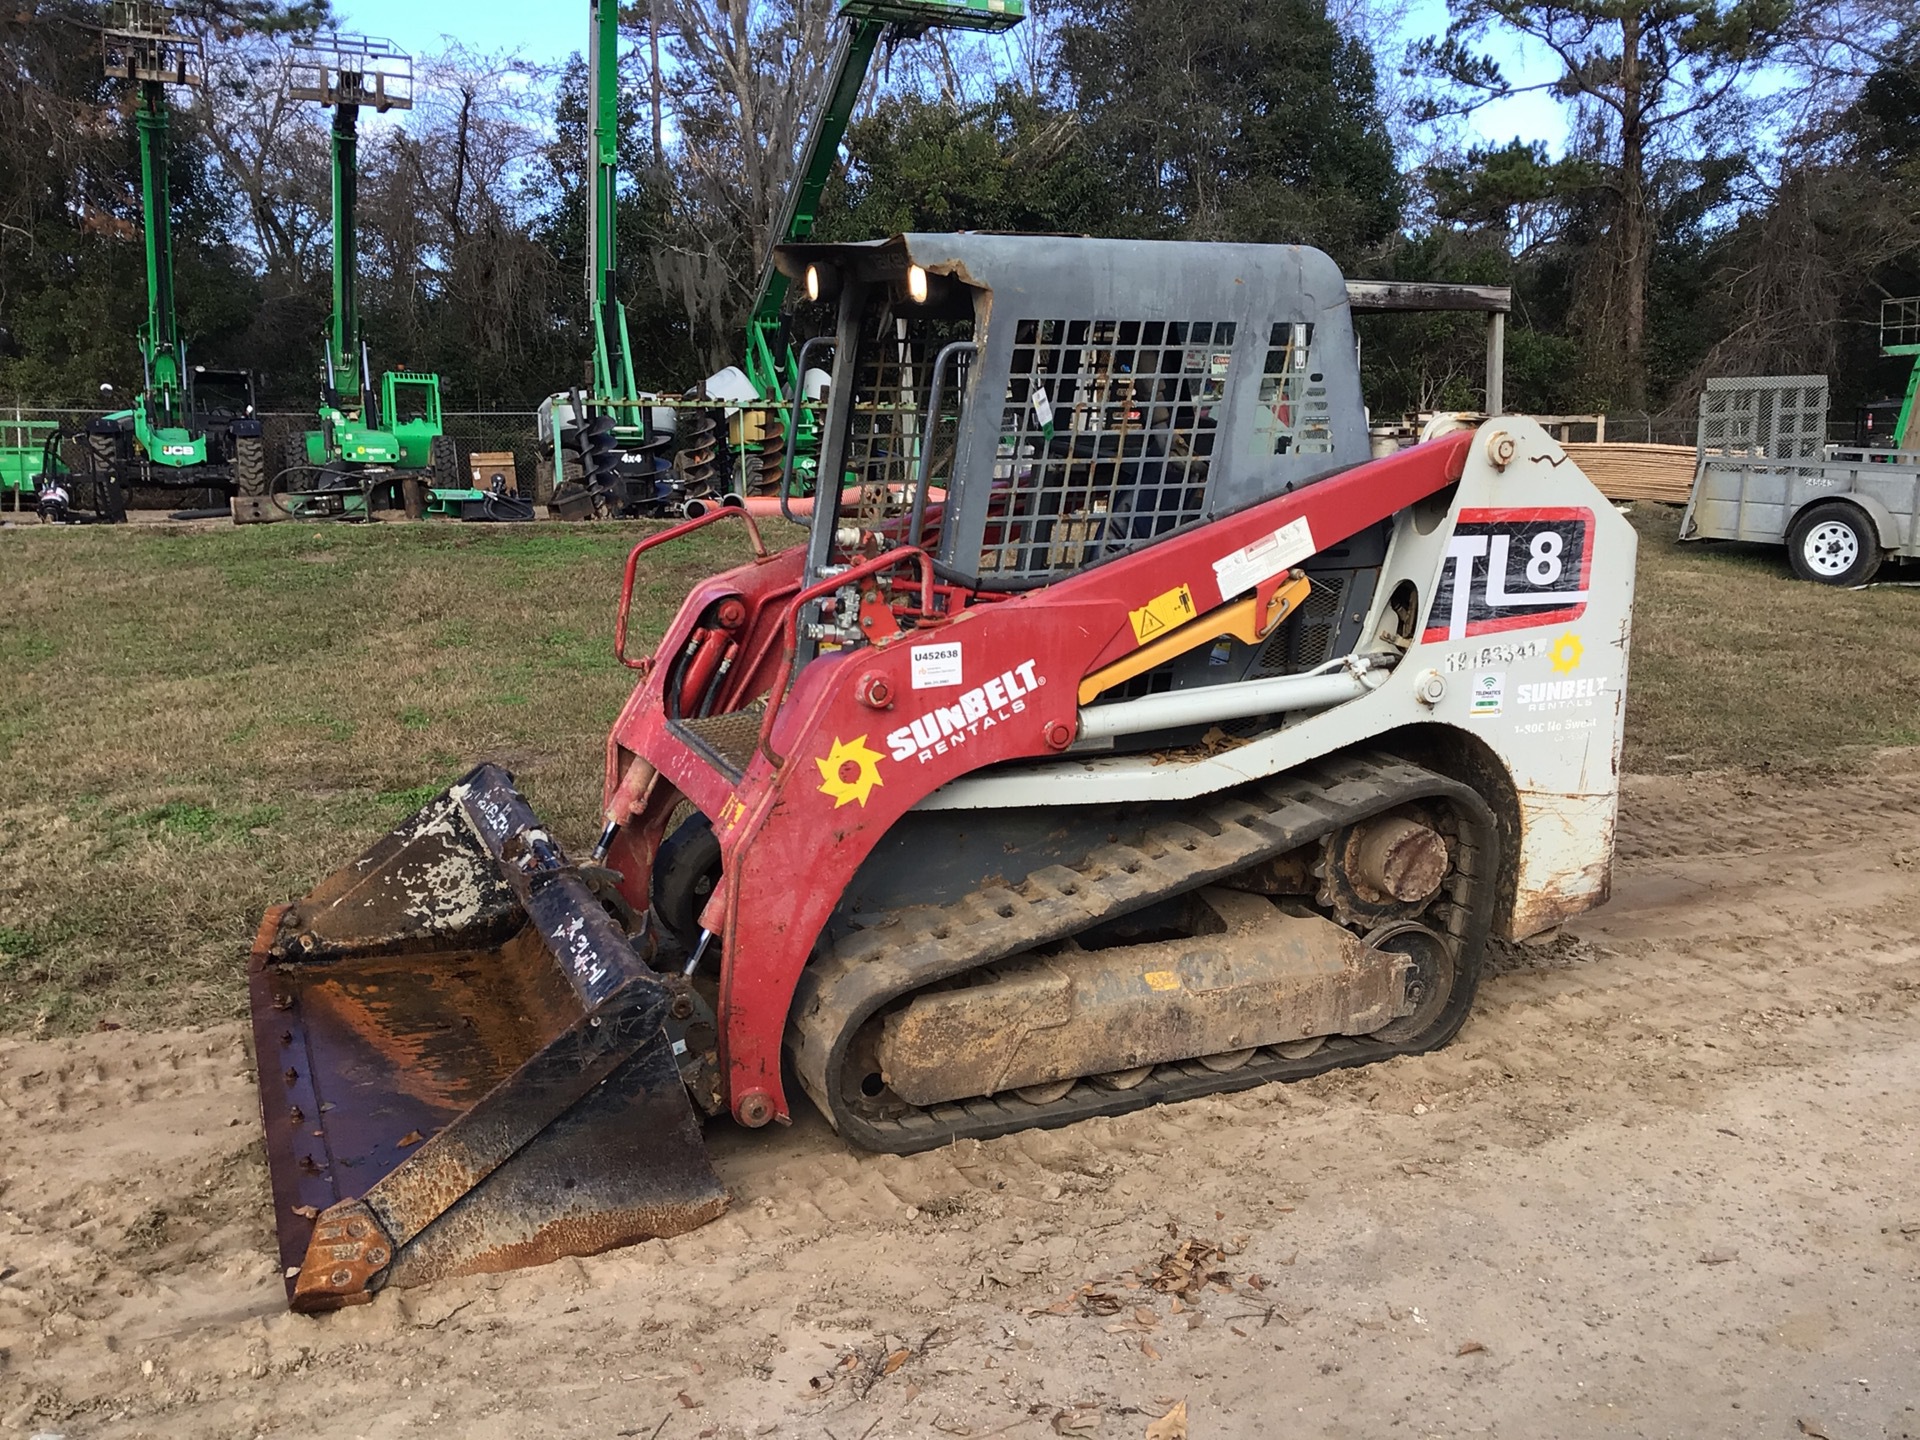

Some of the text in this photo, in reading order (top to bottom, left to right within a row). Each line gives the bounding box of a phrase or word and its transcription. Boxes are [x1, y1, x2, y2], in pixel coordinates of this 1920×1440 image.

[163, 445, 194, 456] JCB
[621, 453, 642, 463] 4x4
[1446, 531, 1588, 640] TL8
[914, 650, 958, 661] U452638
[1517, 677, 1608, 704] SUNBELT
[886, 659, 1038, 762] SUNBELT
[1528, 698, 1593, 712] RENTALS
[918, 700, 1027, 764] RENTALS
